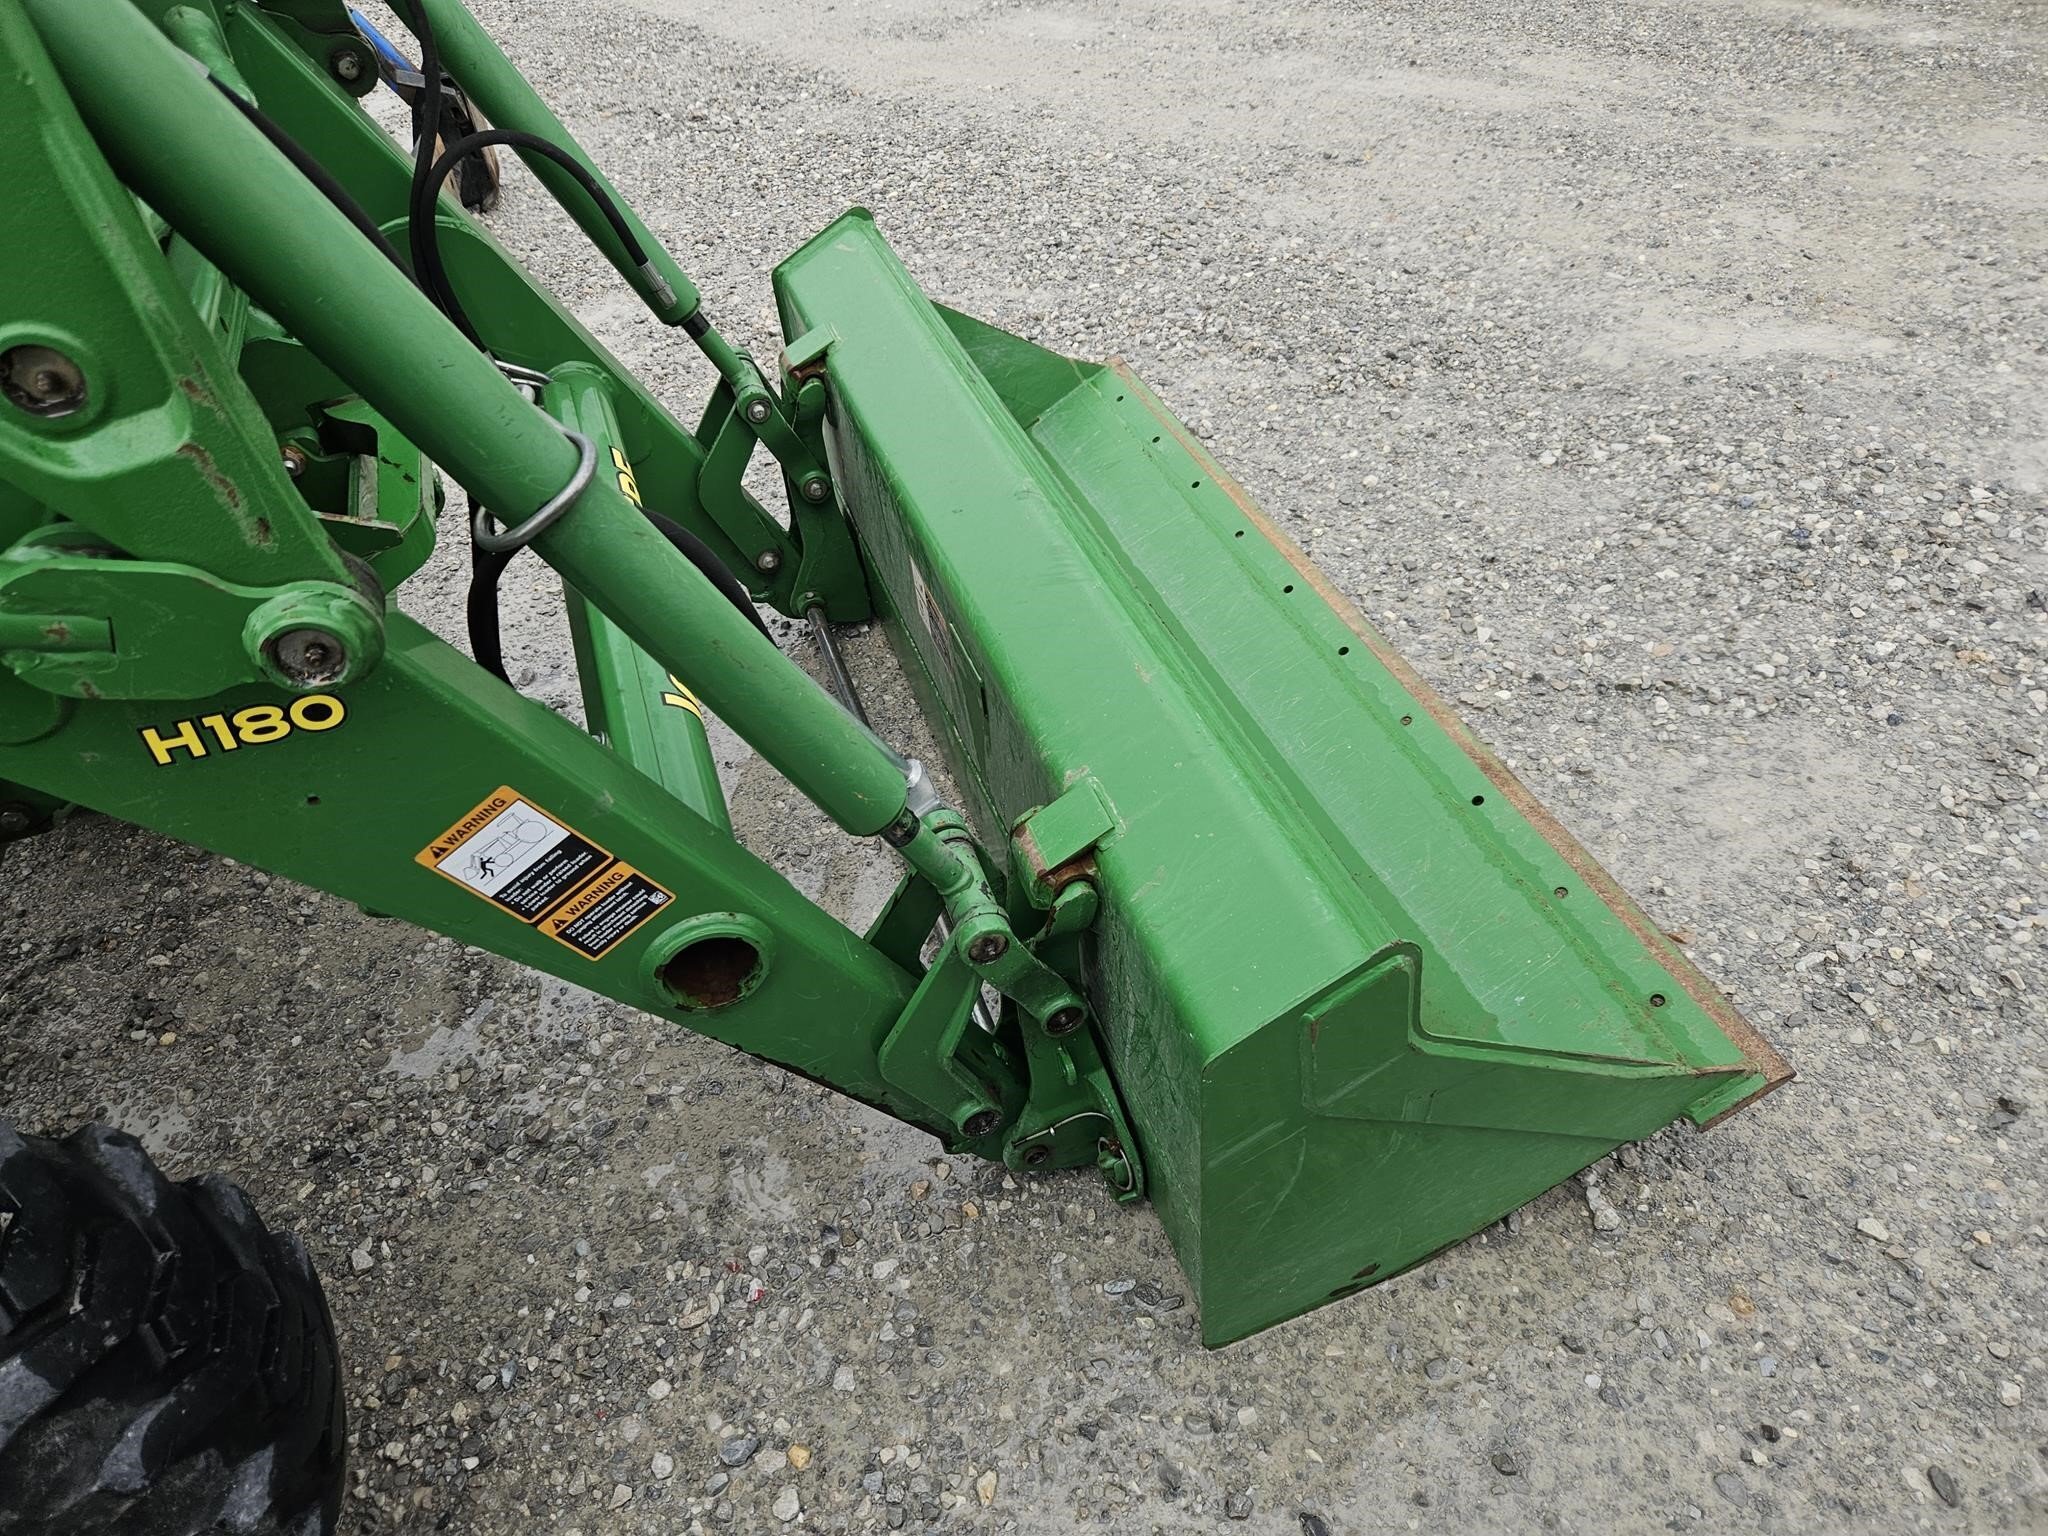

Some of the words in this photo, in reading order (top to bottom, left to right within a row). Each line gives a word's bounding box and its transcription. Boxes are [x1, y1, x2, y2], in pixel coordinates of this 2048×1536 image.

[141, 693, 346, 766] H180
[443, 798, 506, 845] WARNING
[507, 882, 520, 893] avoid
[520, 872, 534, 882] injury
[533, 862, 546, 872] from
[545, 850, 562, 862] falling
[521, 891, 538, 904] service
[538, 880, 552, 891] under
[556, 864, 571, 876] raised
[522, 888, 531, 896] not
[549, 860, 568, 875] perform
[525, 896, 540, 908] Lower
[540, 884, 555, 896] loader
[562, 865, 579, 879] ground
[579, 855, 592, 865] when
[566, 873, 624, 915] WARNING
[574, 919, 584, 928] NOT
[585, 906, 602, 919] operate
[601, 895, 615, 906] loader
